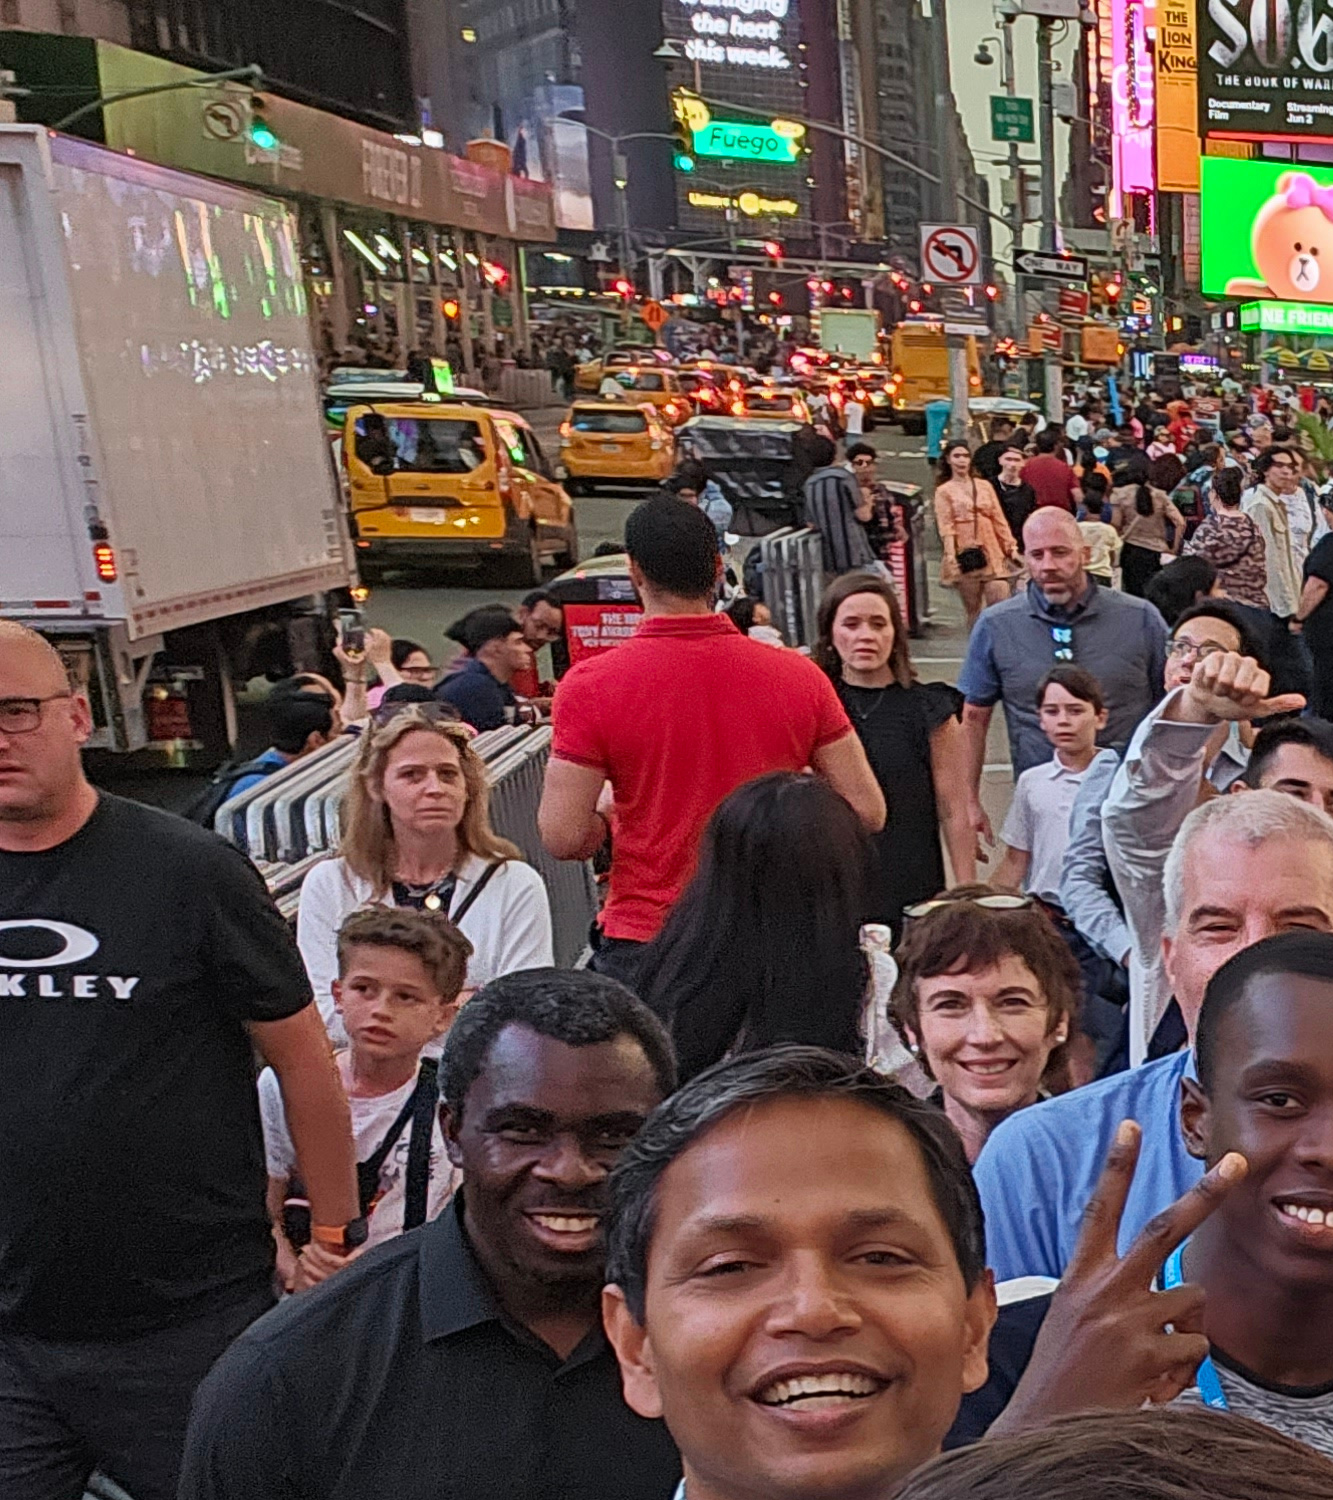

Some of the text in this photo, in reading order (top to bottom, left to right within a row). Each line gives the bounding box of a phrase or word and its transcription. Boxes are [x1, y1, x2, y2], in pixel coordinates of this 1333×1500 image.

[1164, 10, 1188, 24] THE
[691, 12, 782, 40] the heat
[684, 38, 726, 62] this
[1158, 50, 1197, 73] KING
[1216, 73, 1240, 86] THE
[1283, 77, 1299, 89] OF
[1208, 98, 1271, 112] Documentary
[1208, 109, 1230, 121] Film
[1286, 112, 1314, 124] Jun 2
[709, 128, 779, 155] Fuego
[1023, 257, 1079, 273] ONE WAY
